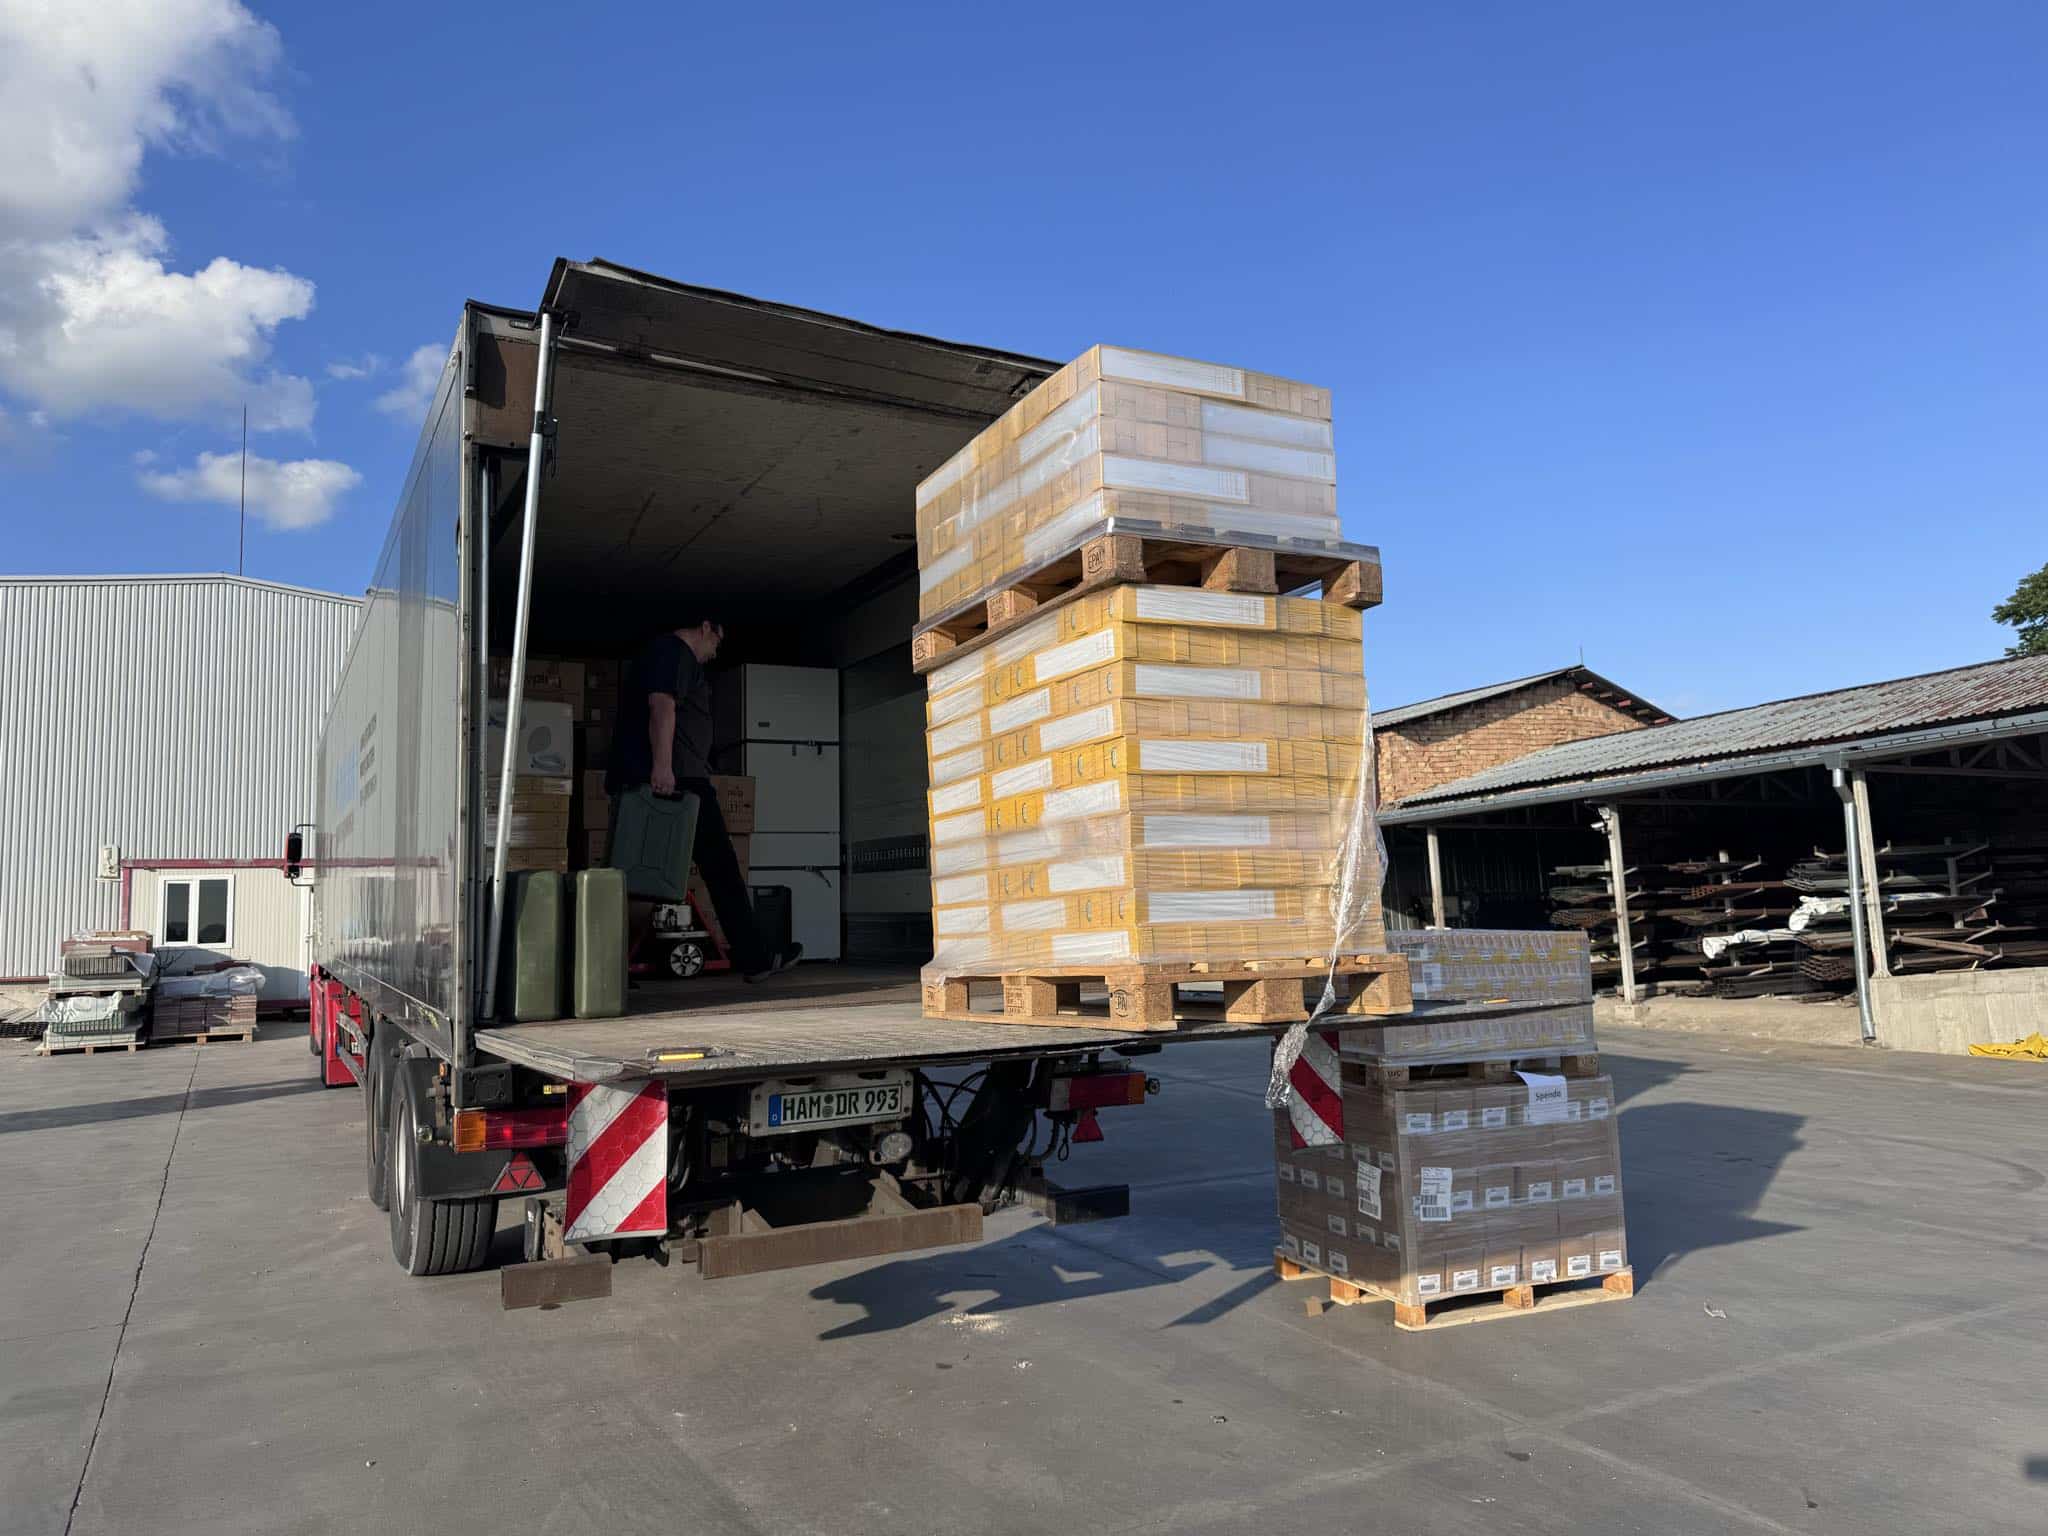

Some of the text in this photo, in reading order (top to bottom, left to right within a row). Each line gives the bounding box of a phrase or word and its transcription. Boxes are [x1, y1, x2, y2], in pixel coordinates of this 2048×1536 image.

[783, 1088, 899, 1121] HAM DR 993
